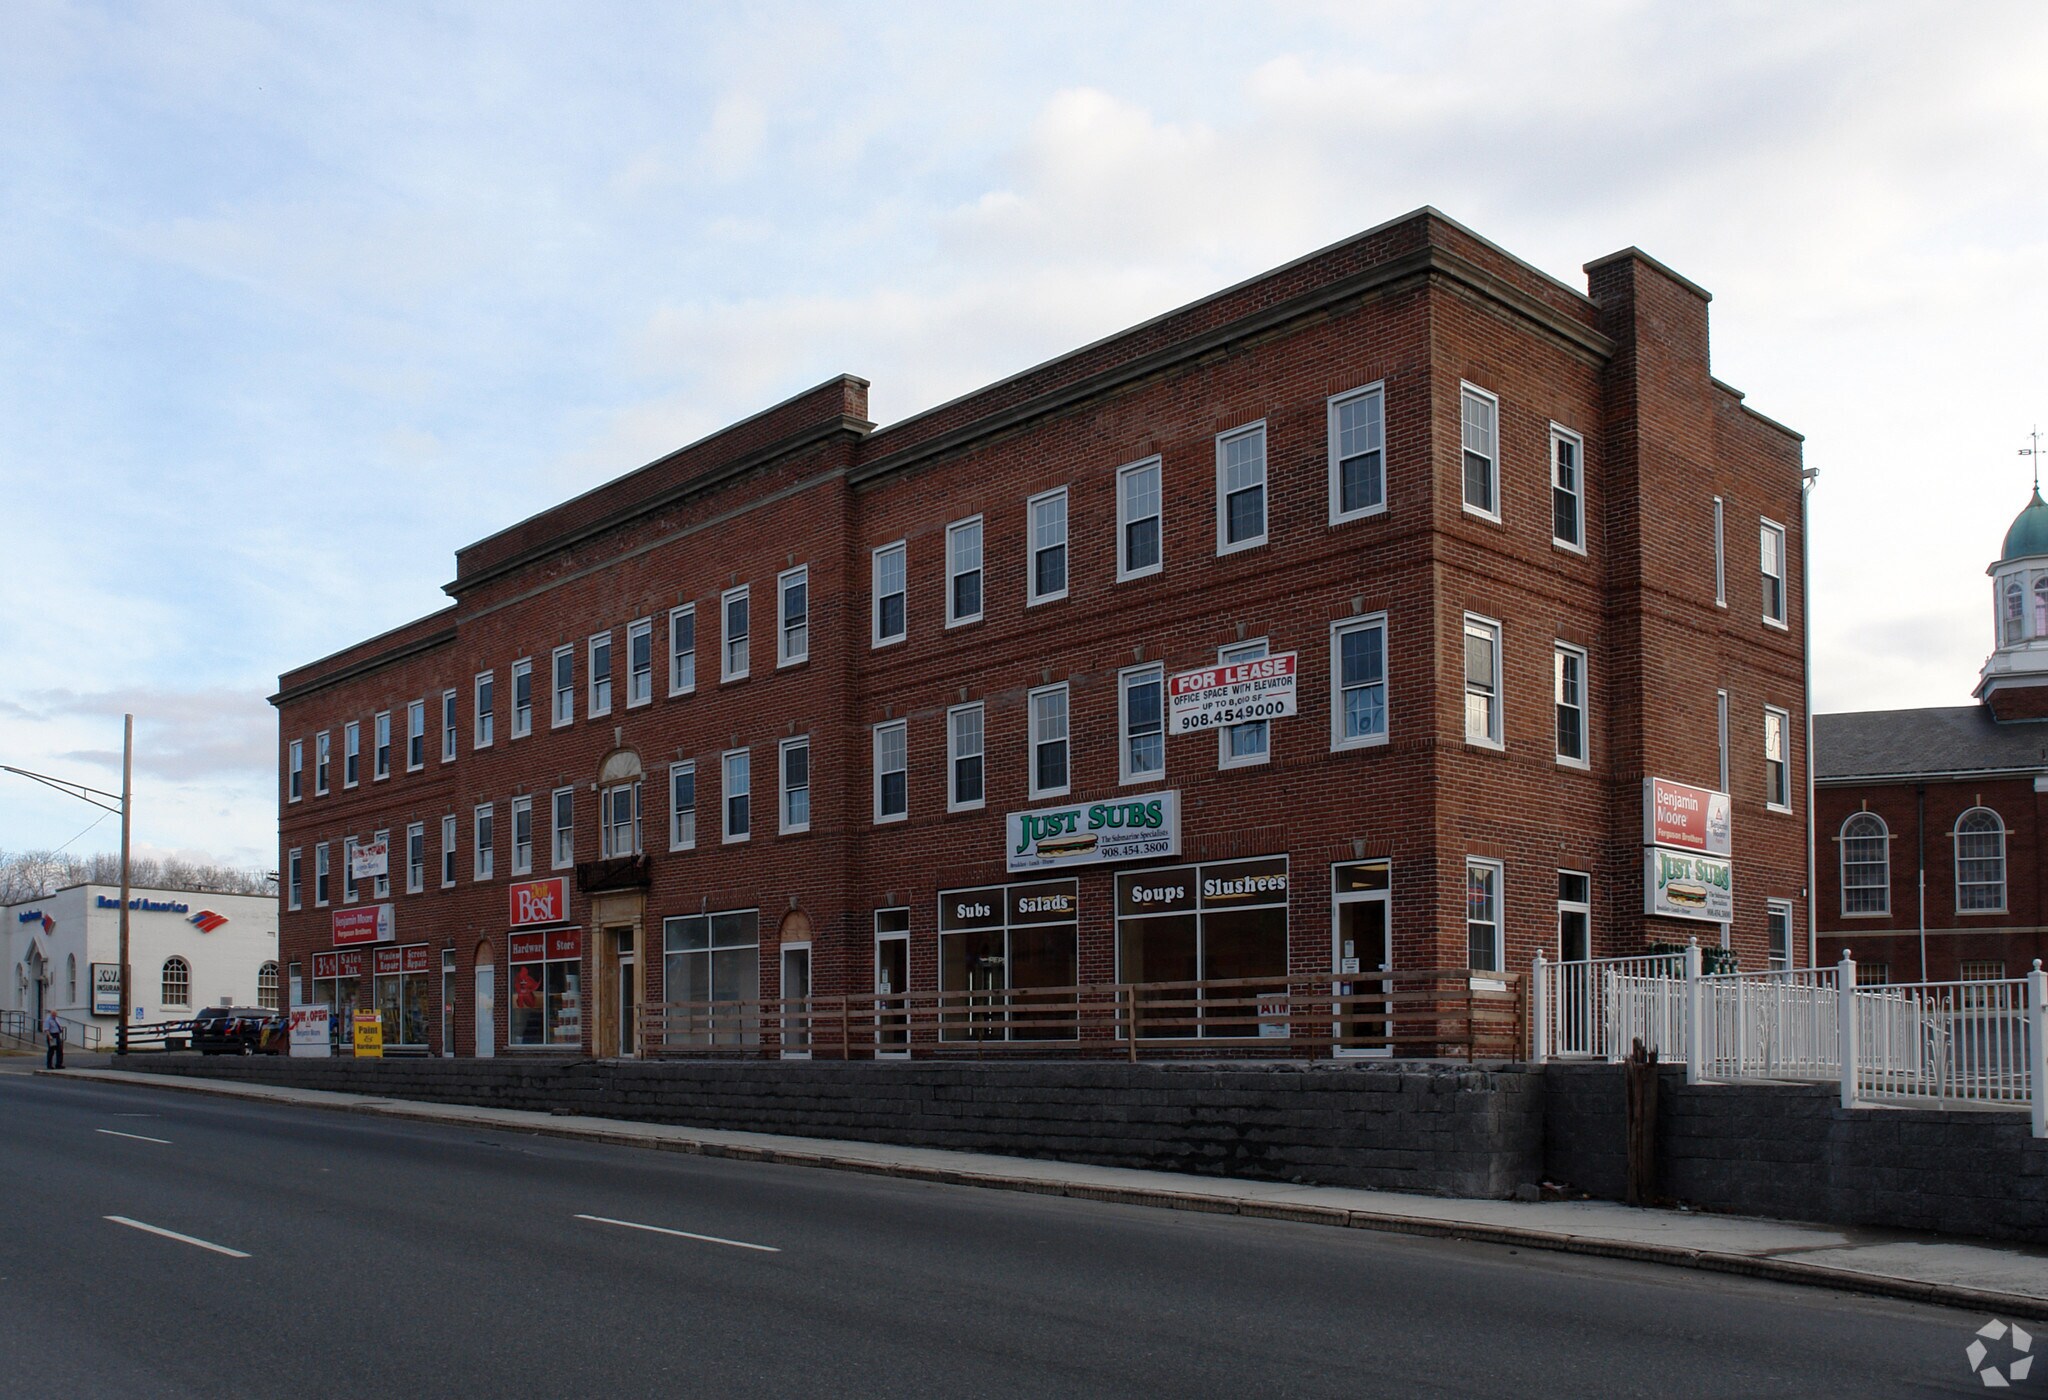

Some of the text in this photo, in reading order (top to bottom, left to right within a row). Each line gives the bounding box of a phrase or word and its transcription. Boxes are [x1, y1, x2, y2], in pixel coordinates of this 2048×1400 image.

[1178, 659, 1287, 693] FOR LEASE
[1174, 692, 1200, 706] OFFICE
[1203, 687, 1228, 700] SPACE
[1254, 676, 1293, 691] ELEVATOR
[1202, 703, 1213, 711] UP
[1216, 700, 1227, 708] TO
[1252, 693, 1262, 702] SF
[1657, 787, 1698, 811] Benjamin
[1657, 806, 1687, 827] Moore
[1016, 800, 1163, 854] JUST SUBS
[1112, 833, 1139, 842] Submarine
[1140, 829, 1169, 841] Specialists
[1657, 828, 1681, 840] Ferguson
[1682, 832, 1704, 844] Brothers
[1101, 842, 1169, 858] 908.454.3800
[1658, 853, 1729, 891] JUST SUBS
[1131, 884, 1185, 903] Soups
[1203, 874, 1286, 897] Slushees
[97, 895, 188, 914] Ban of America
[518, 890, 554, 922] Best
[957, 902, 991, 919] Subs
[1018, 894, 1069, 913] Salads
[336, 914, 373, 928] Benjamin Moore
[556, 940, 575, 951] Store
[341, 953, 361, 964] Sales
[378, 951, 400, 961] Window
[407, 949, 427, 959] Screen
[345, 964, 358, 975] Tax
[380, 962, 399, 971] Repair
[407, 959, 427, 969] Repair
[310, 1009, 328, 1021] OPEN
[358, 1025, 378, 1034] Paint
